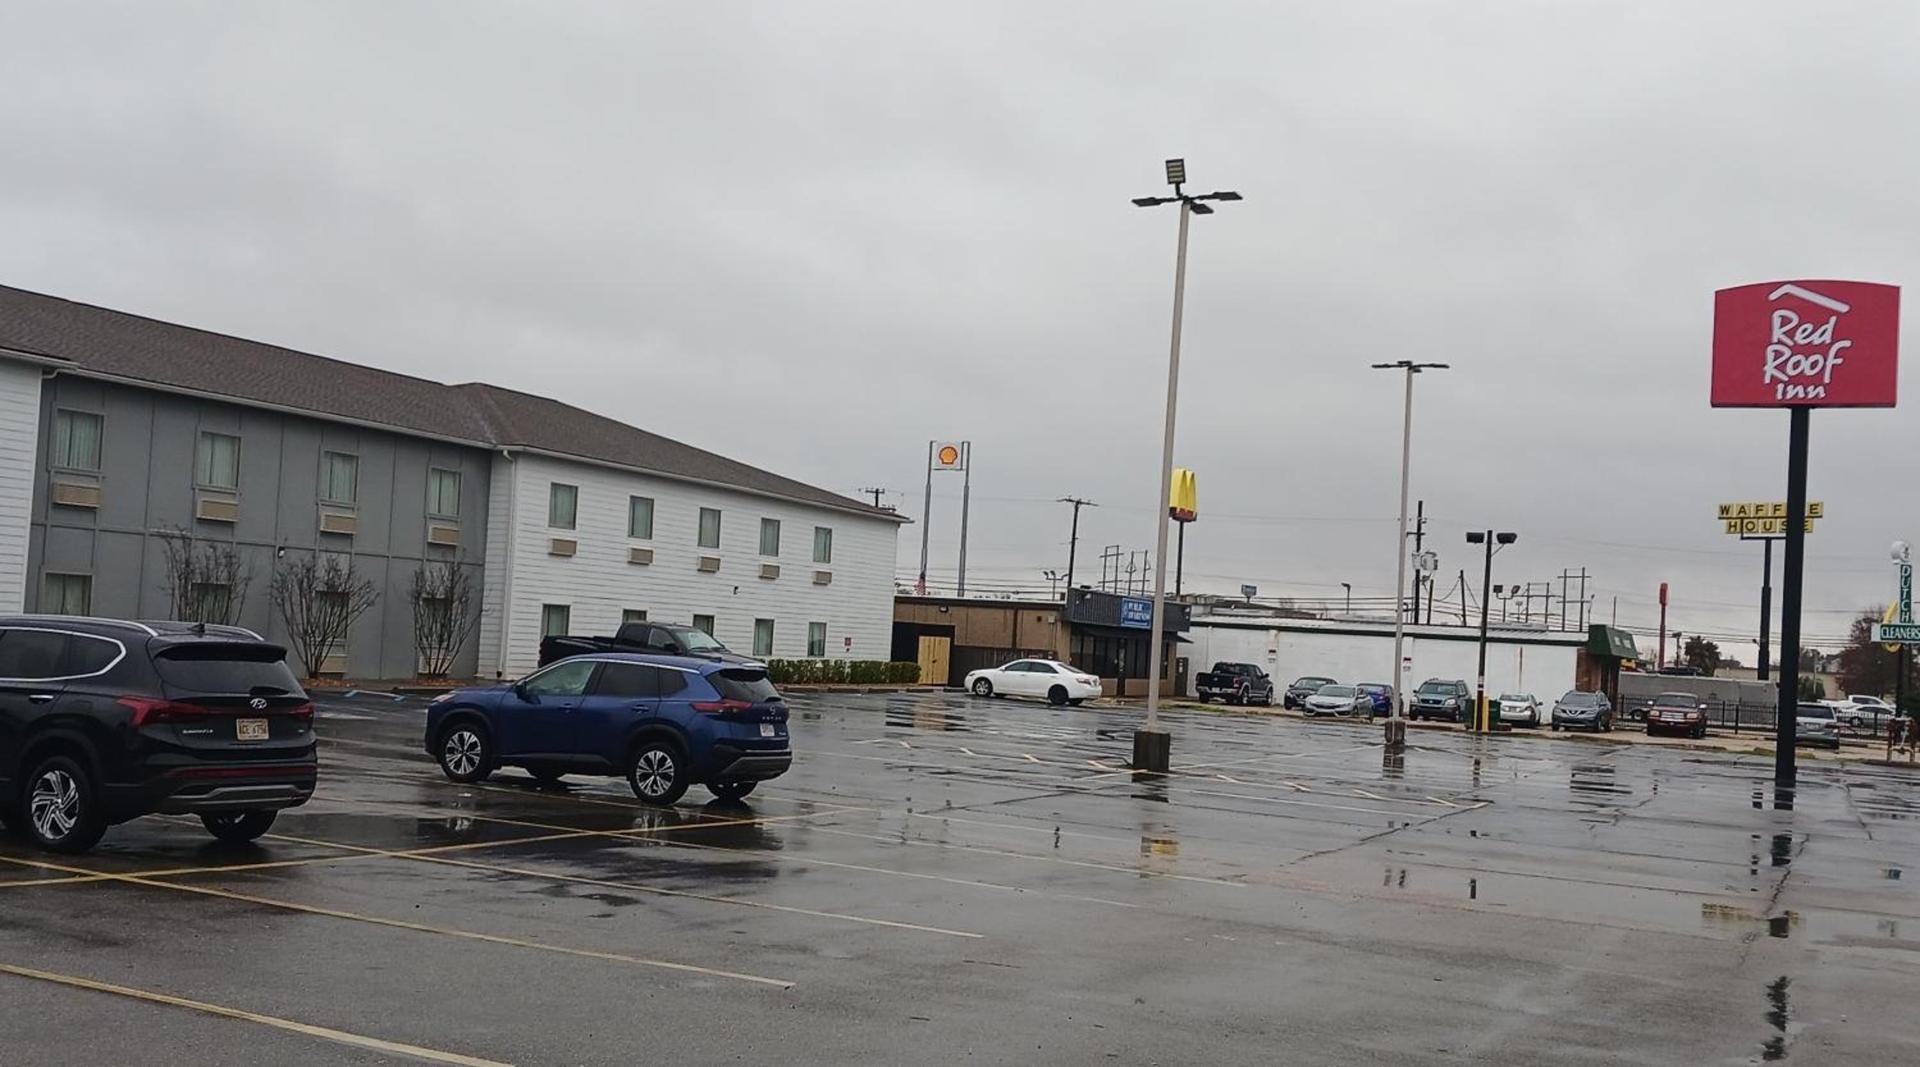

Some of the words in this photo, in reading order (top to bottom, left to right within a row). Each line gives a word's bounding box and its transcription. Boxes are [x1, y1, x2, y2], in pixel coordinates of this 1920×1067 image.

[1771, 309, 1838, 347] Red
[1763, 340, 1852, 384] Roof
[1720, 503, 1820, 516] WAFFE
[1900, 565, 1912, 622] DUTCH
[1881, 626, 1920, 640] CLEANERS
